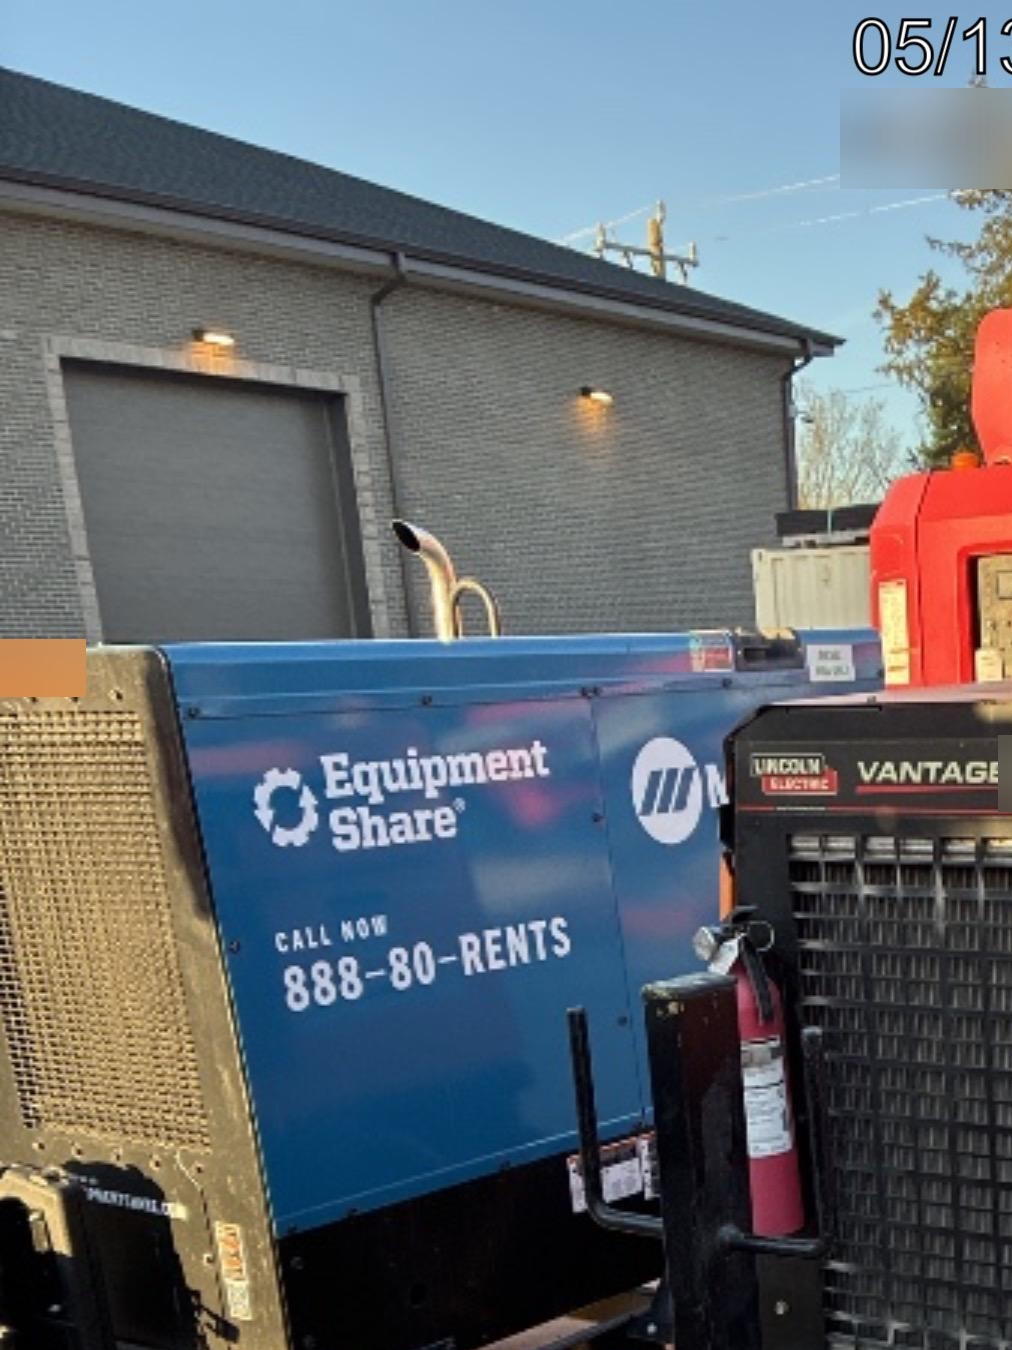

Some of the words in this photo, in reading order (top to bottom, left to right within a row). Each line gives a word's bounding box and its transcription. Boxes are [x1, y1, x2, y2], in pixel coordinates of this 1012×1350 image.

[320, 741, 550, 804] Equipment
[754, 757, 821, 776] LINCOLN
[275, 924, 332, 953] CALL
[341, 914, 389, 943] NOW
[283, 916, 571, 1012] 888-80-RENTS
